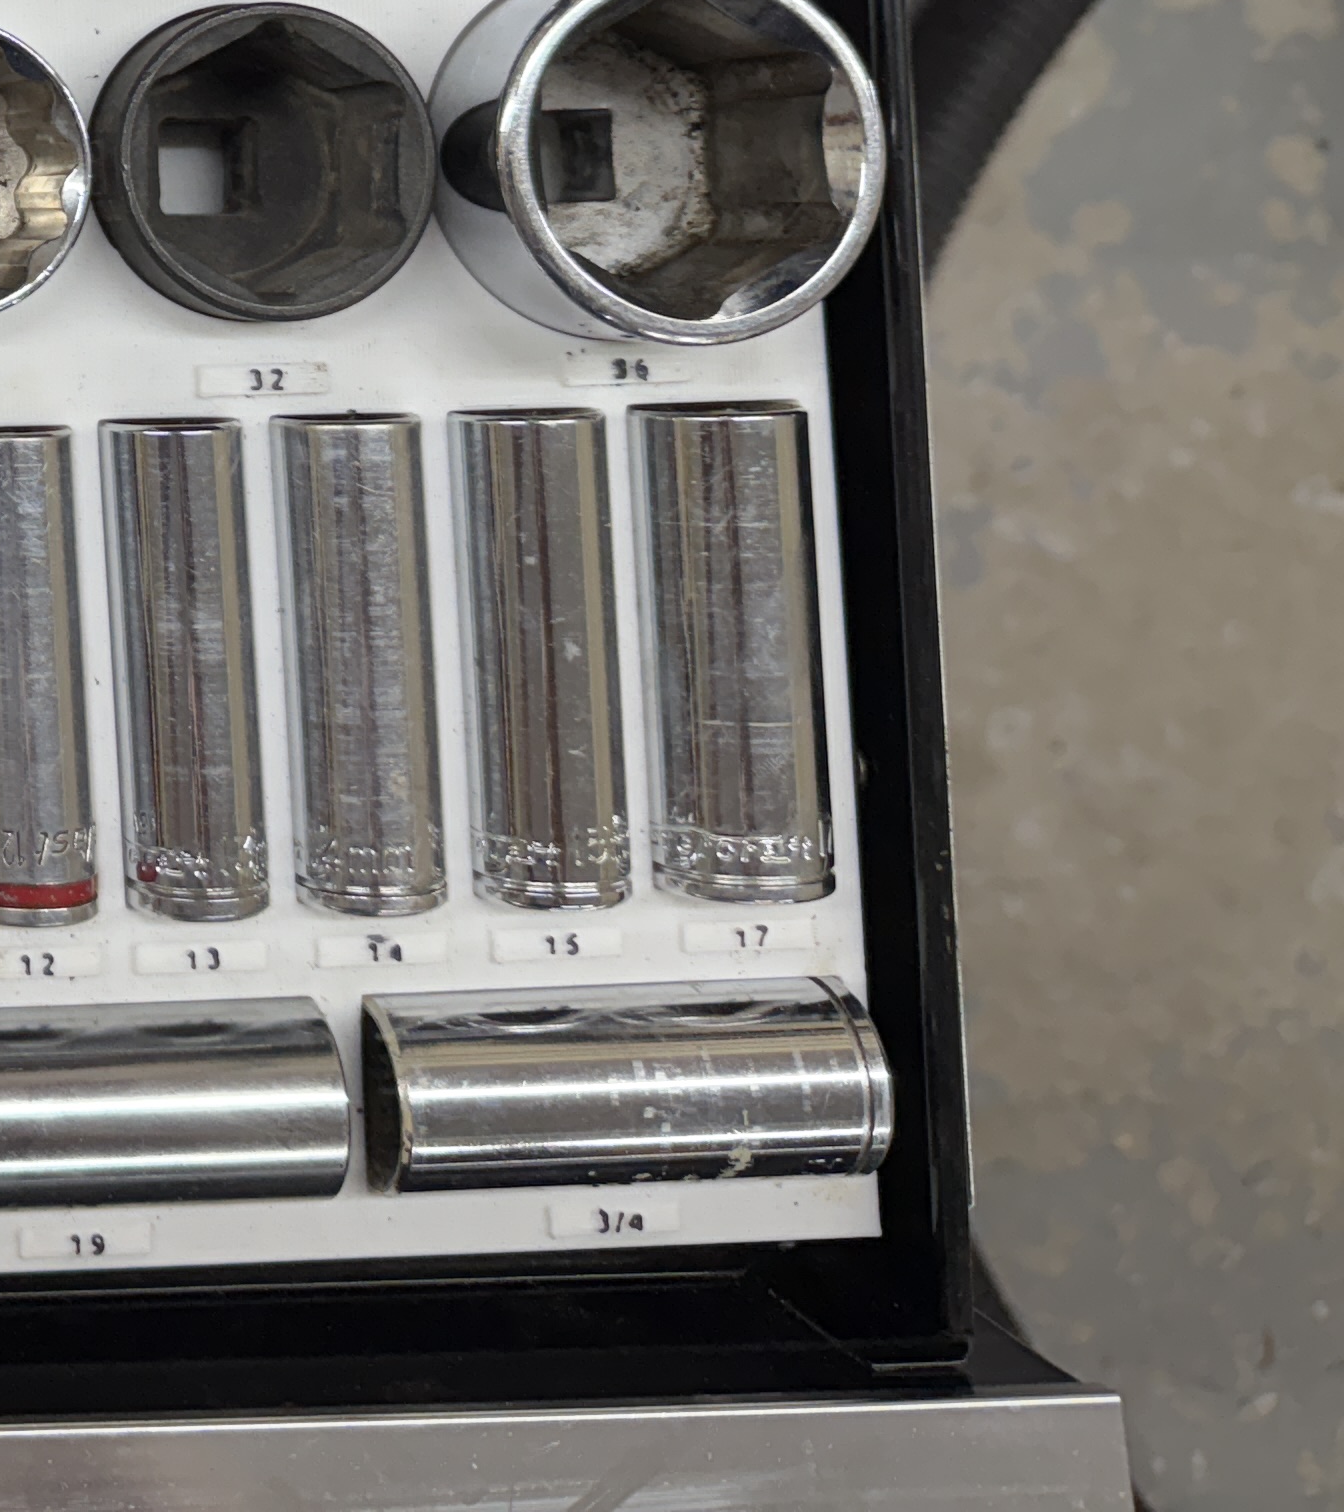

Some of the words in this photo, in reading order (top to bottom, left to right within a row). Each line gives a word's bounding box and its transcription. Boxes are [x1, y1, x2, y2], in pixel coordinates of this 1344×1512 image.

[250, 369, 283, 390] 32
[546, 934, 579, 955] 15
[736, 925, 768, 947] 17
[21, 953, 54, 976] 12
[188, 948, 220, 970] 13
[71, 1234, 105, 1256] 19
